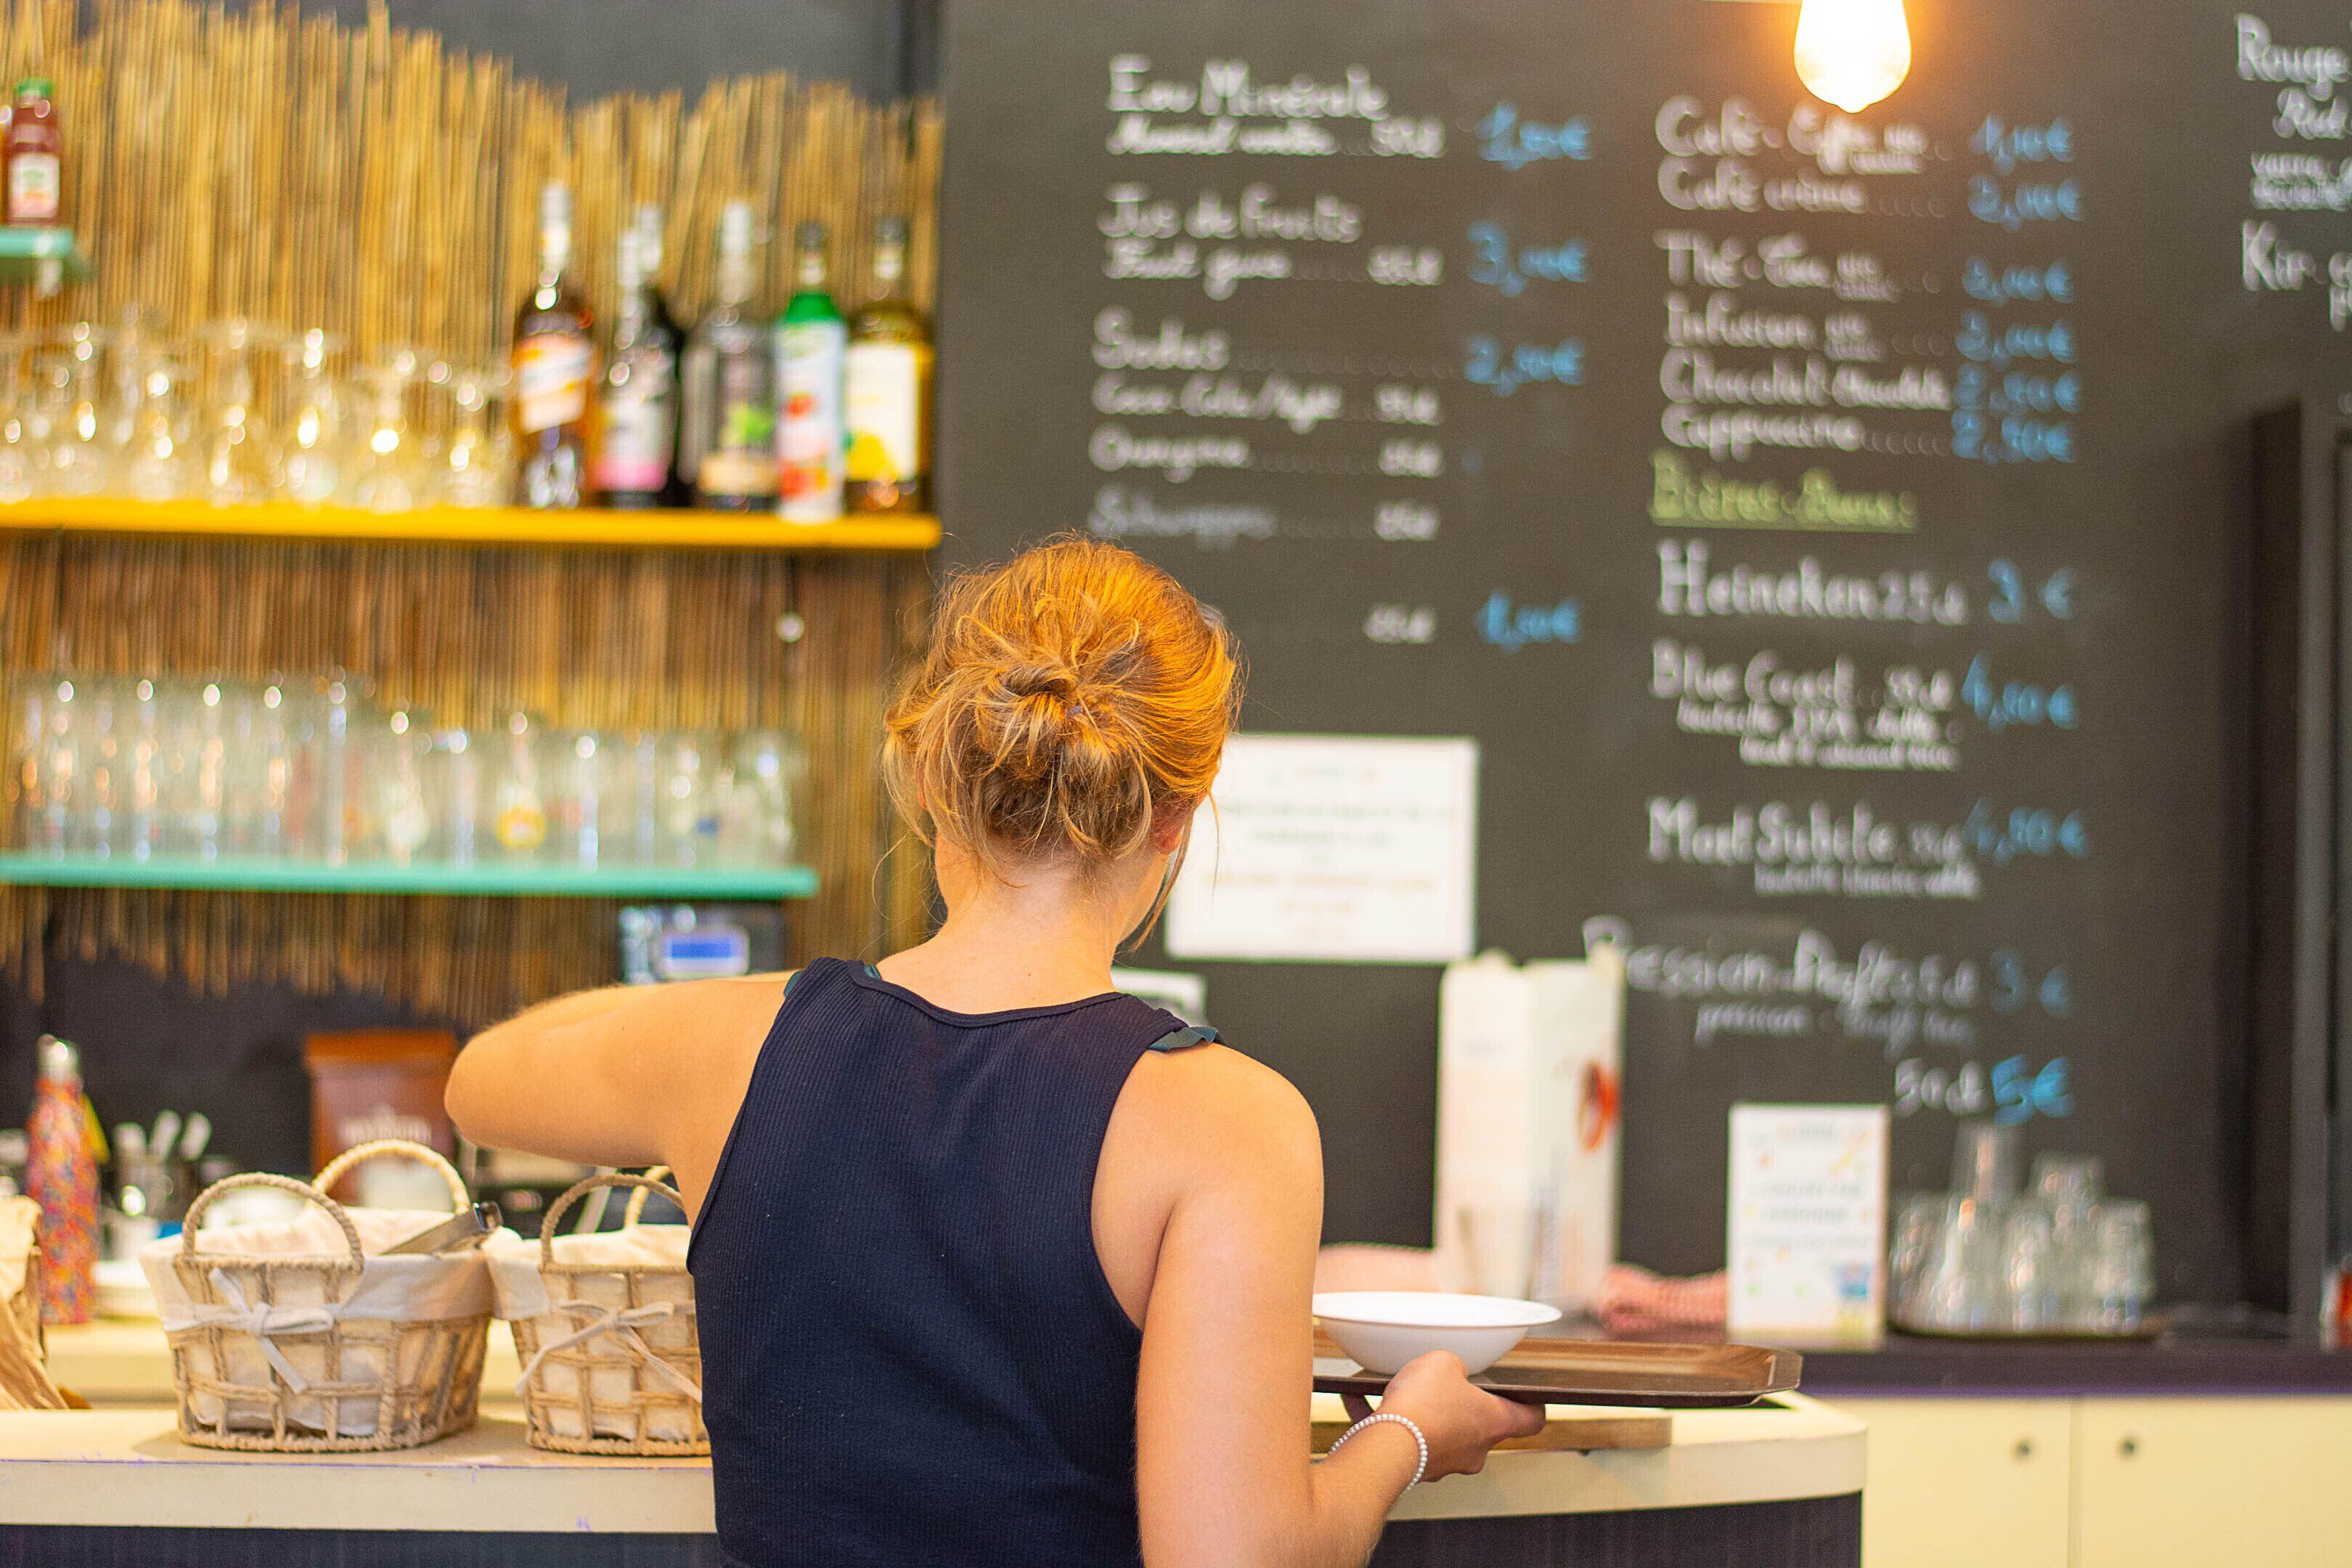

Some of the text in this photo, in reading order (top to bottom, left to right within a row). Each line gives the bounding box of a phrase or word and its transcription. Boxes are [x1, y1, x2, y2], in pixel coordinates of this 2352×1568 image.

[1108, 54, 1389, 121] Eau Minérale
[1654, 94, 1760, 157] Café
[1098, 181, 1181, 238] Jus
[1185, 188, 1238, 239] de
[1091, 305, 1230, 371] Sodas
[1657, 539, 1878, 621] Heineken
[1649, 637, 1740, 701] Blue
